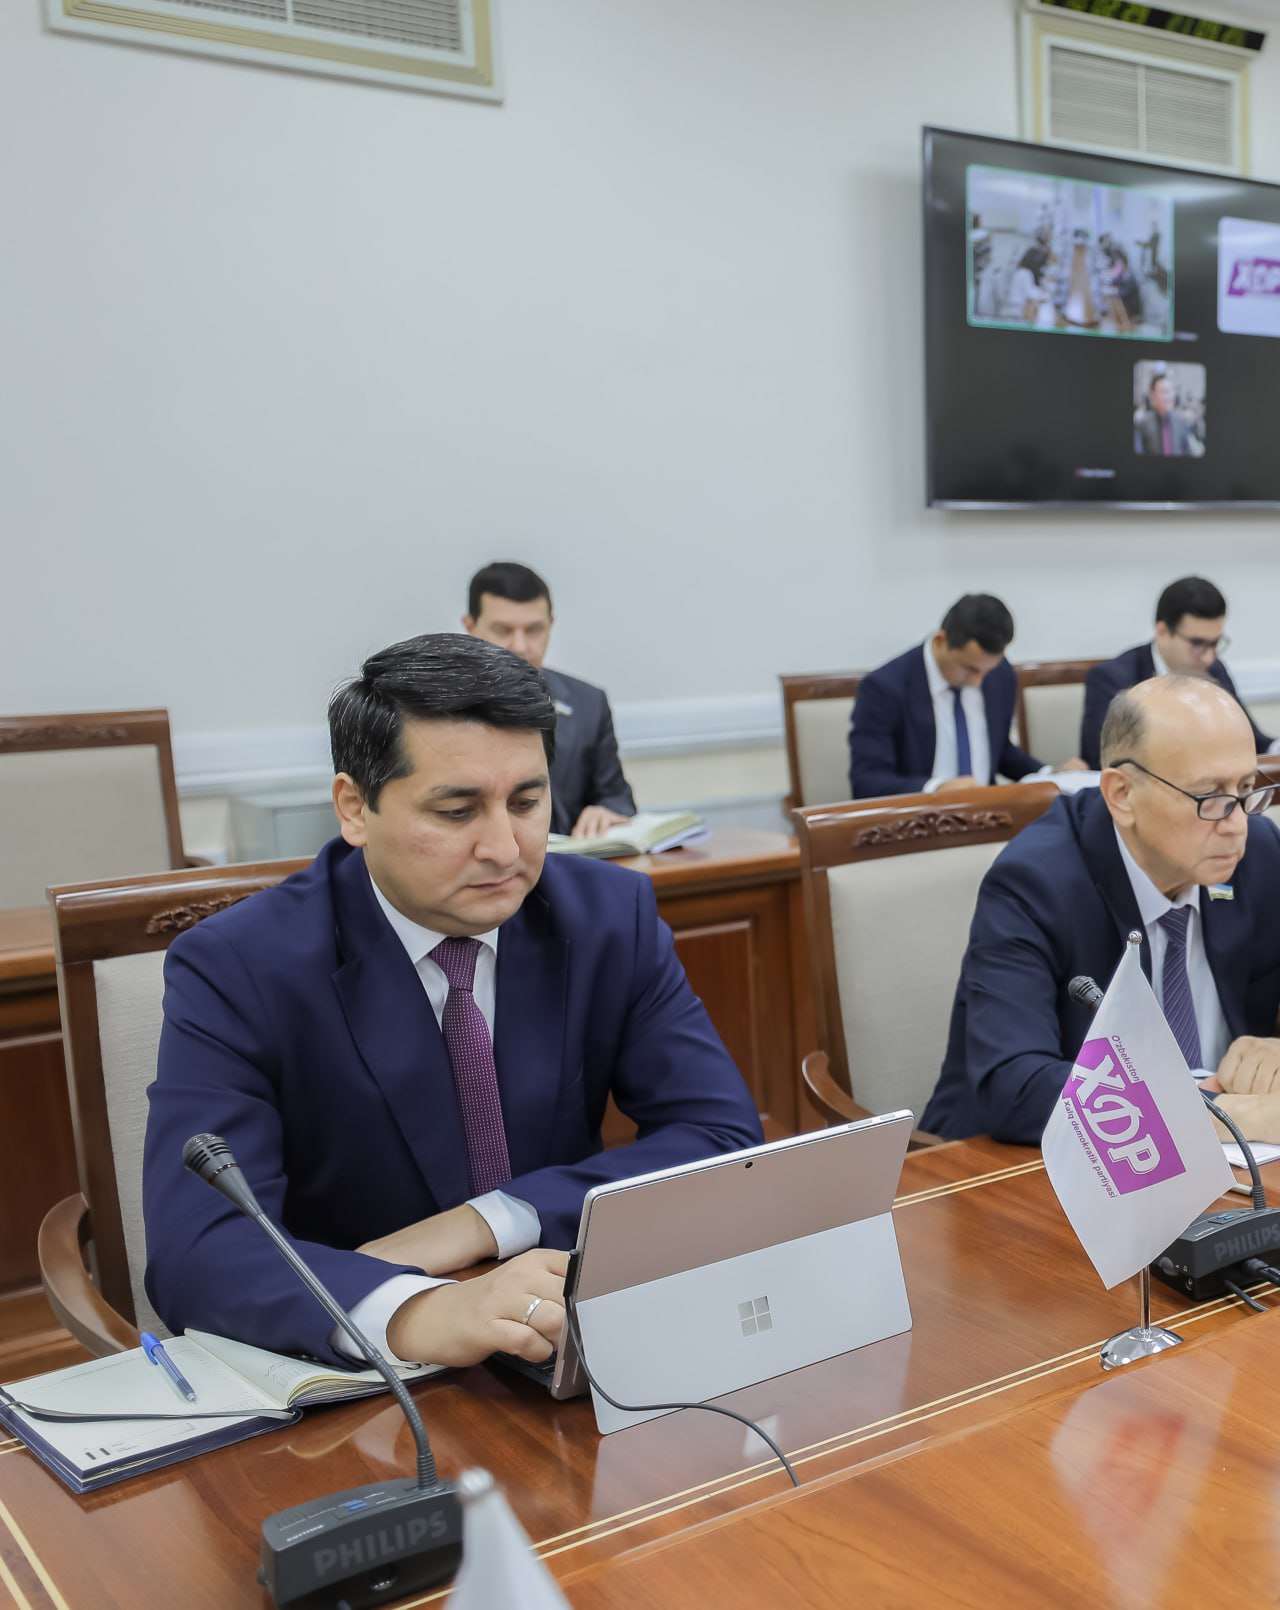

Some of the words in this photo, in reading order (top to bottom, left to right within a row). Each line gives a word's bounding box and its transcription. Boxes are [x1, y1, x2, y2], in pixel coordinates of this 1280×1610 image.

[1111, 1034, 1140, 1082] O'zbekiston
[1063, 1100, 1074, 1119] Xalq
[1071, 1120, 1098, 1168] demokratik
[1094, 1165, 1117, 1199] partiyasi
[1213, 1223, 1280, 1261] PHILIPS
[313, 1509, 448, 1578] PHILIPS
